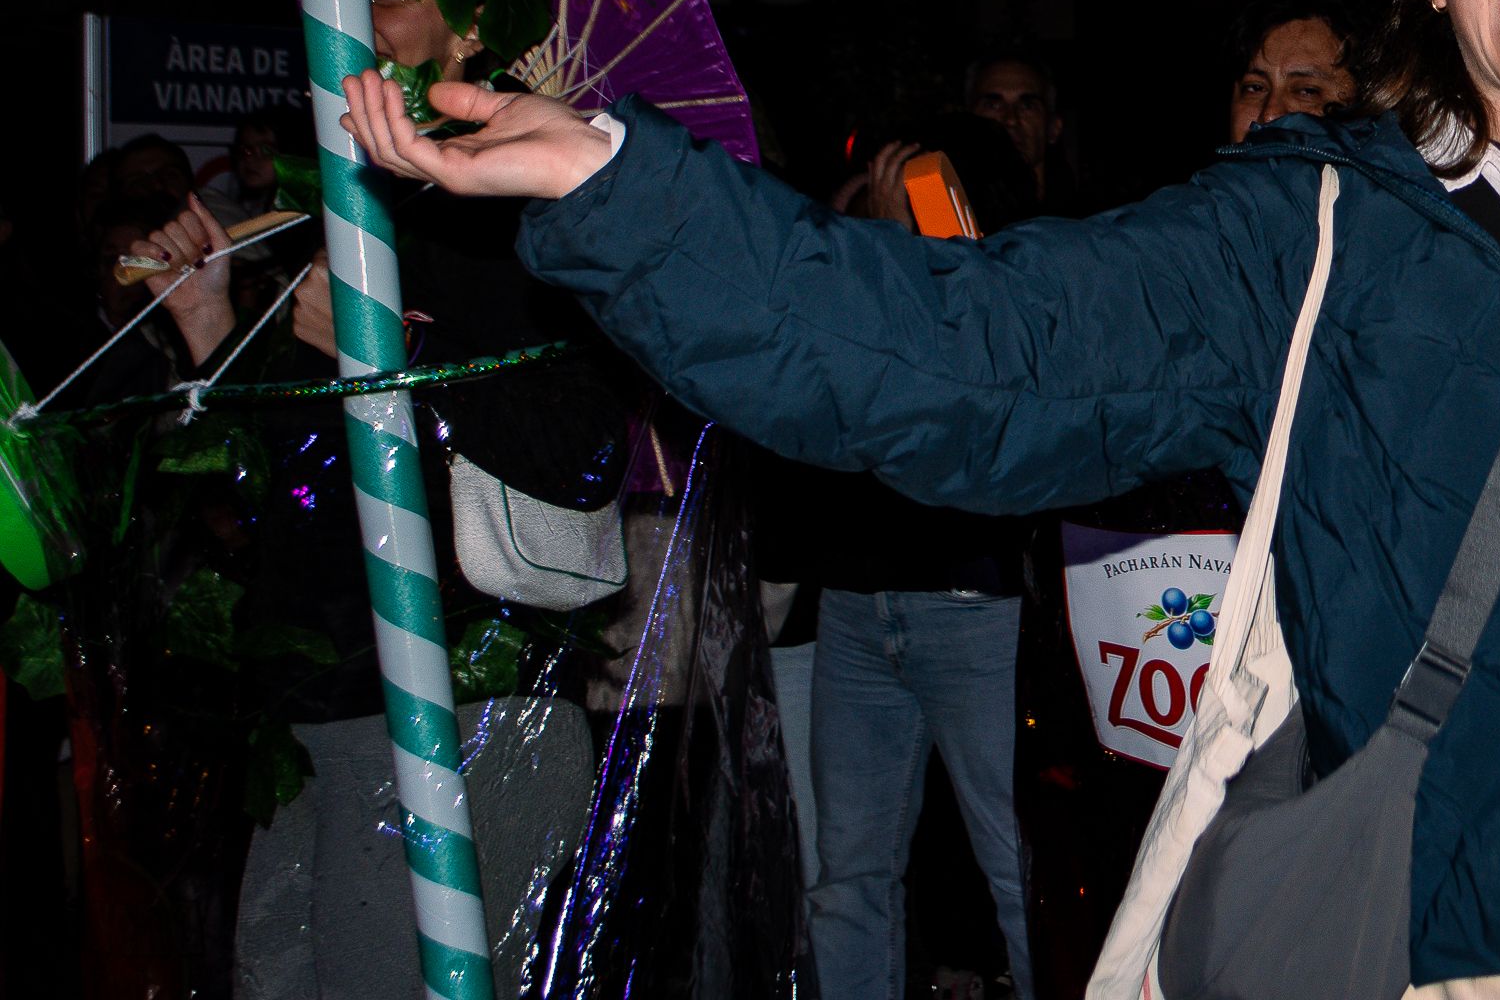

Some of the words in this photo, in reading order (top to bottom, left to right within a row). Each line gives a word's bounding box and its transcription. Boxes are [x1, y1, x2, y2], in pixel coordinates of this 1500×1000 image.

[166, 34, 246, 74] ÀREA
[253, 48, 290, 77] DE
[1103, 553, 1182, 579] PACHARÁN
